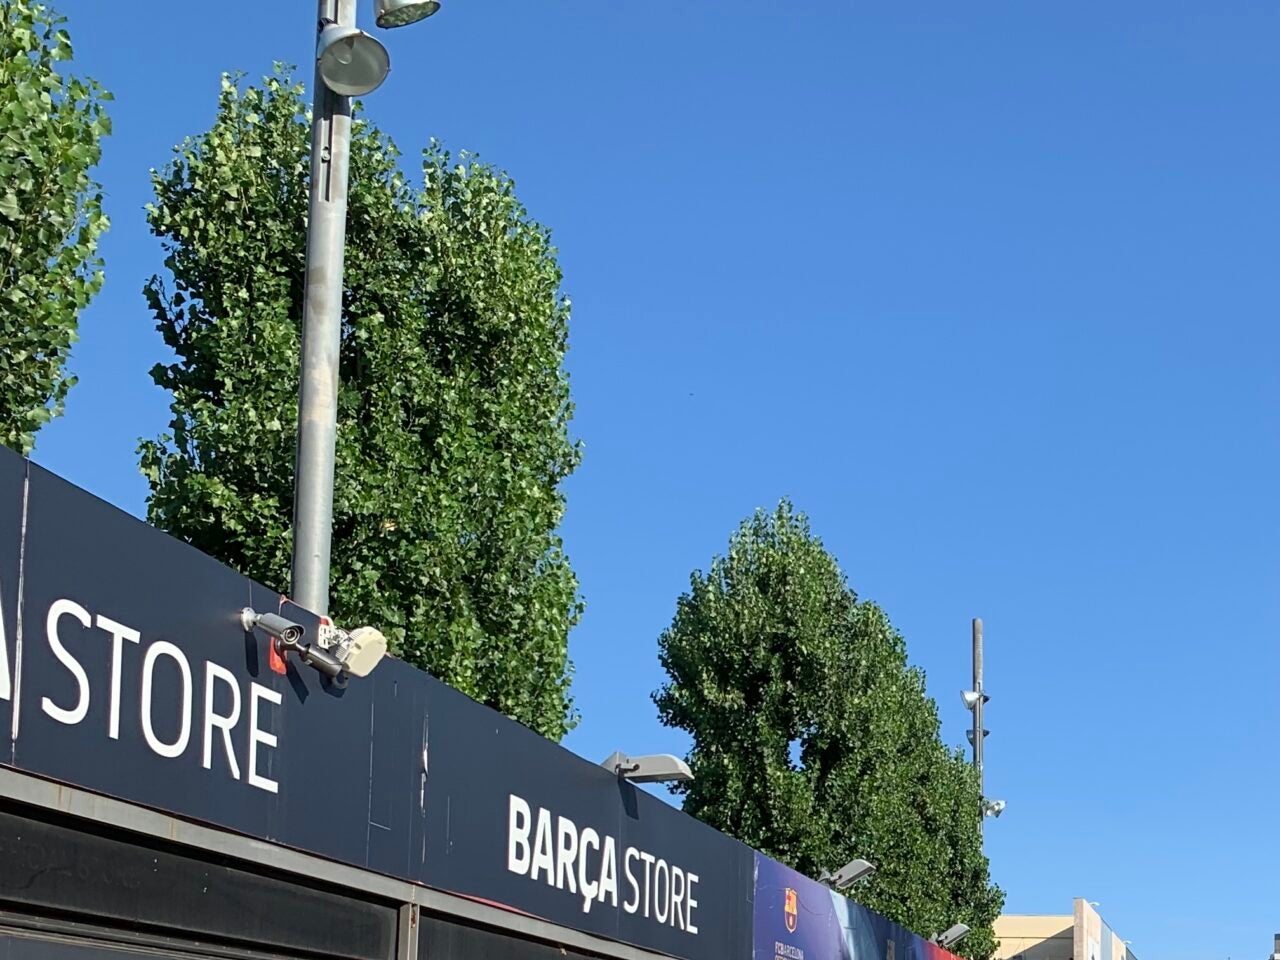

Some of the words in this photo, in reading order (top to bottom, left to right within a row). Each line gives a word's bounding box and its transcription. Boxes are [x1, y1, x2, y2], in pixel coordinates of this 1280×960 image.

[41, 598, 283, 794] STORE
[507, 793, 618, 914] BARÇA
[623, 846, 700, 935] STORE
